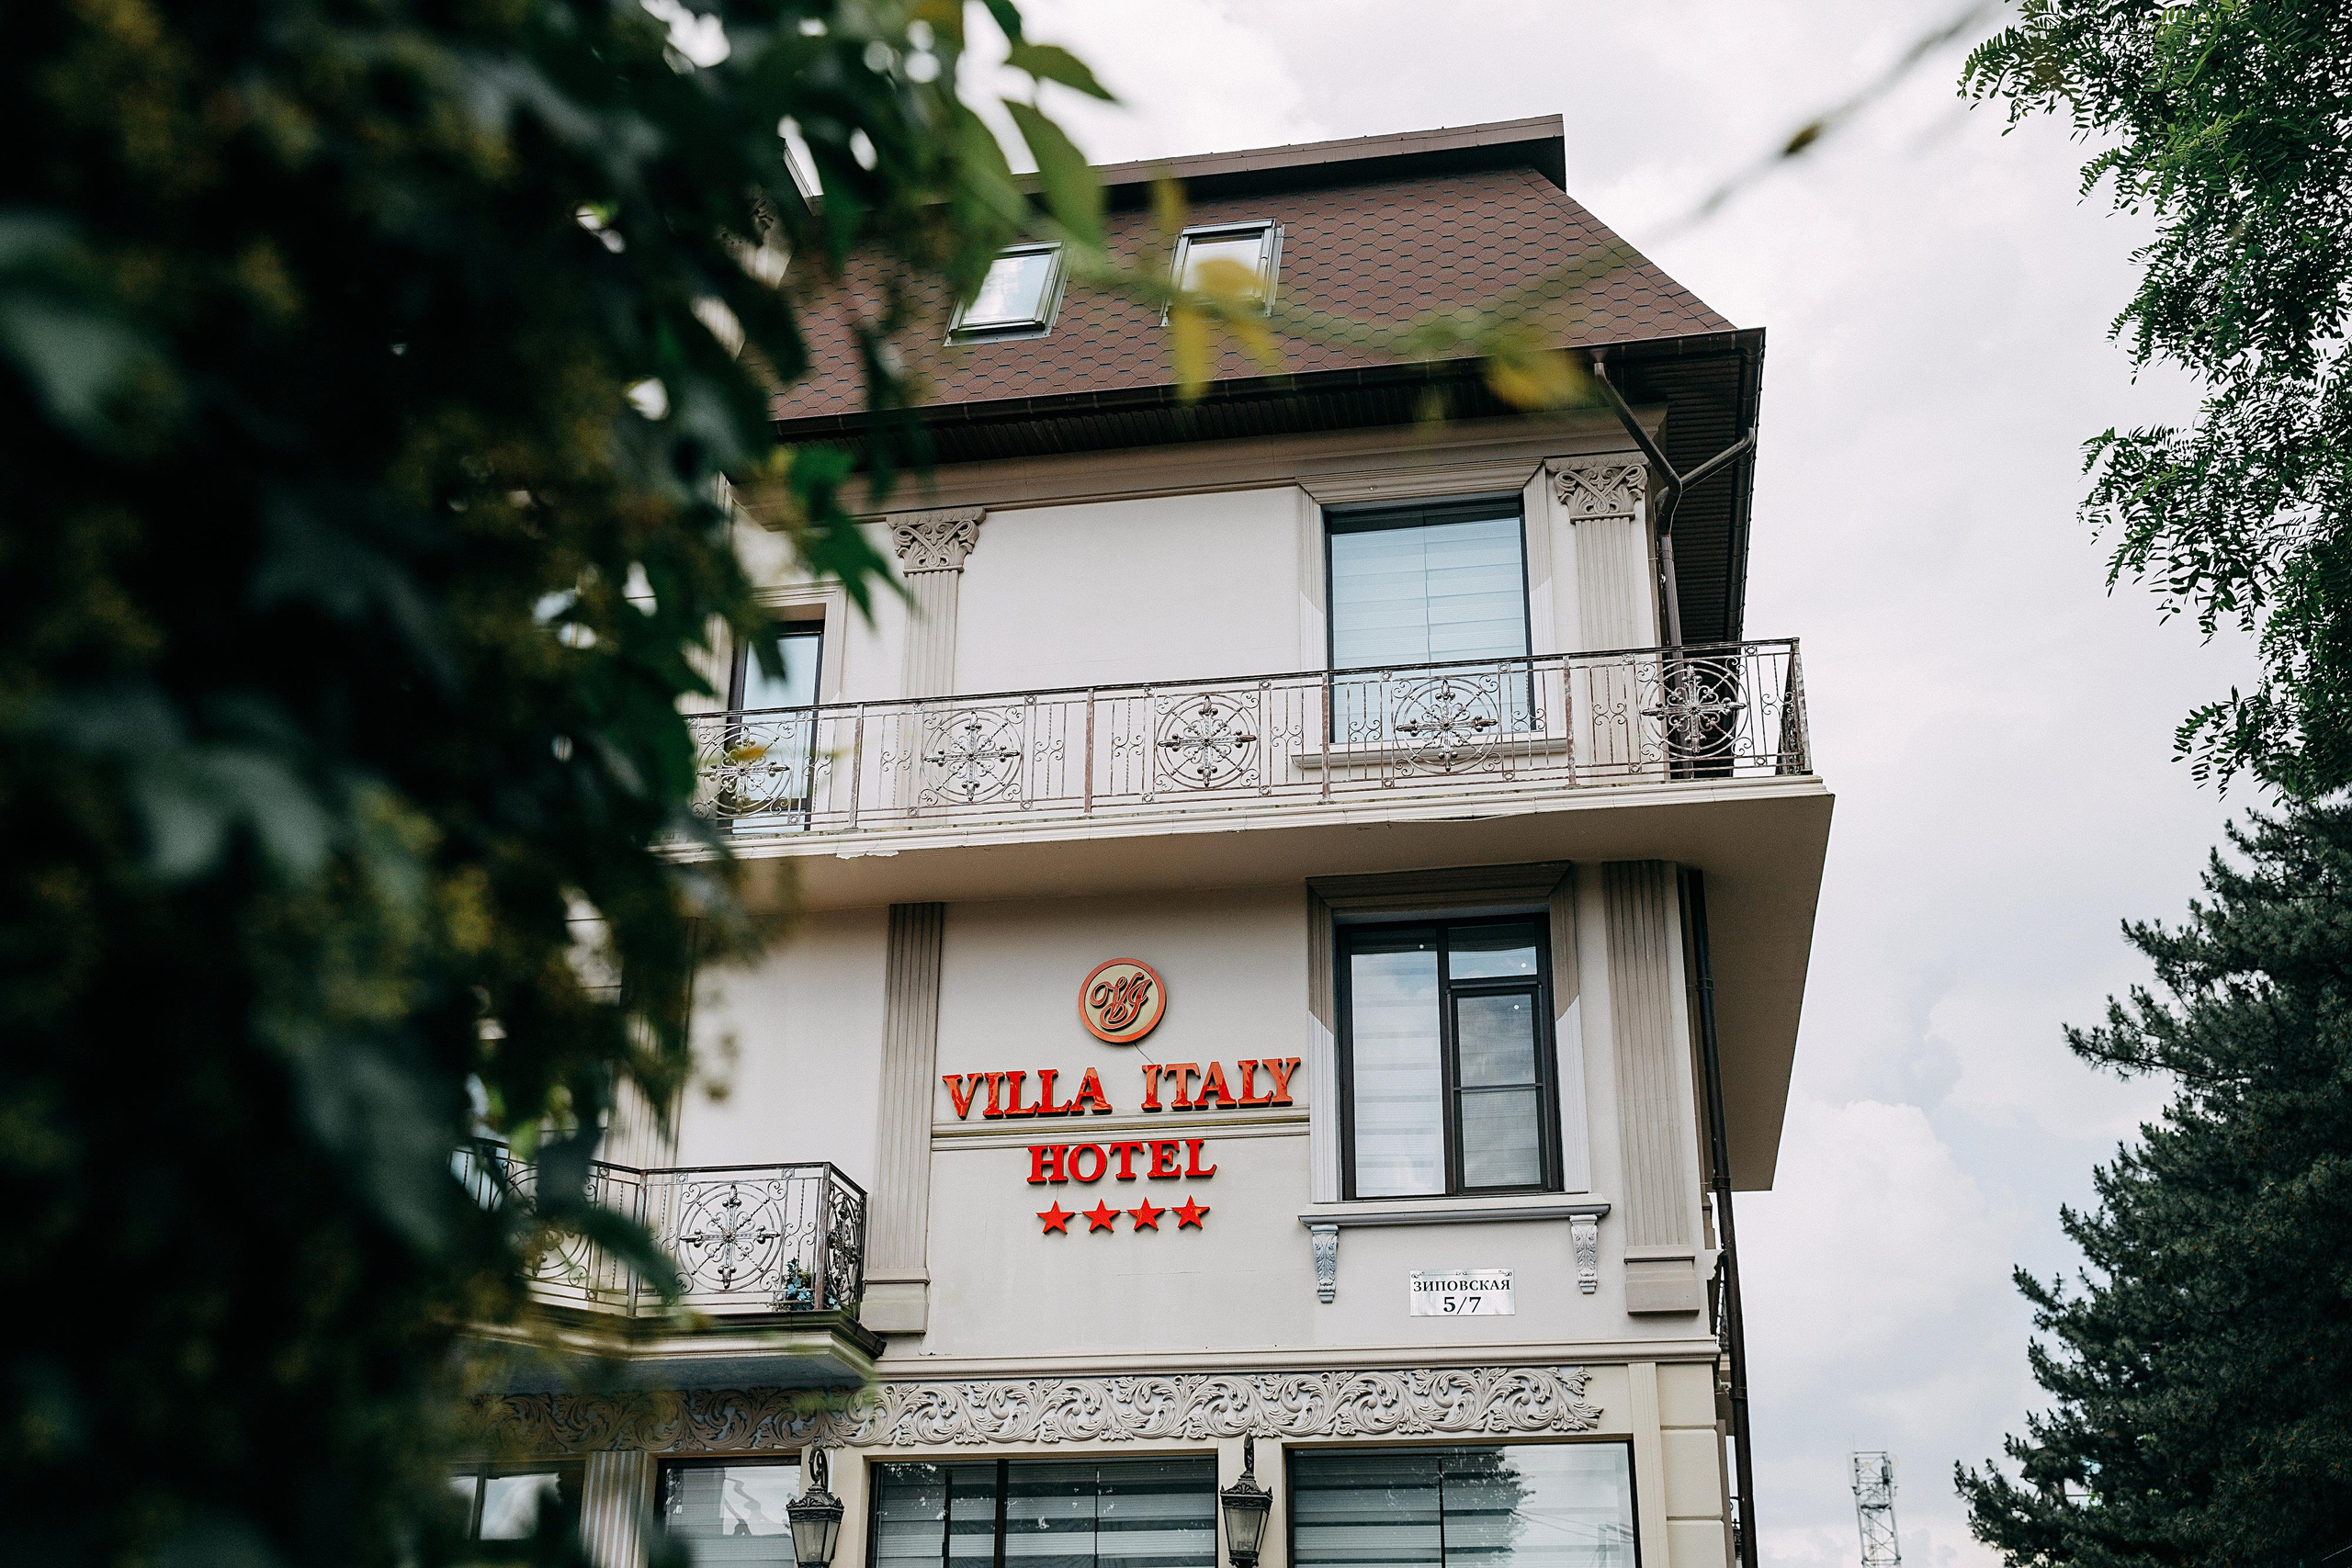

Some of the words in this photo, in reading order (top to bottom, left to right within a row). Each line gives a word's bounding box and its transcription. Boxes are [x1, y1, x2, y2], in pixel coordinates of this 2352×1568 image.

[942, 1066, 1113, 1120] VILLA
[1140, 1057, 1302, 1113] ITALY
[1026, 1138, 1217, 1184] HOTEL
[1413, 1280, 1511, 1292] ЗИПОВСКАЯ
[1442, 1296, 1482, 1314] 5/7
